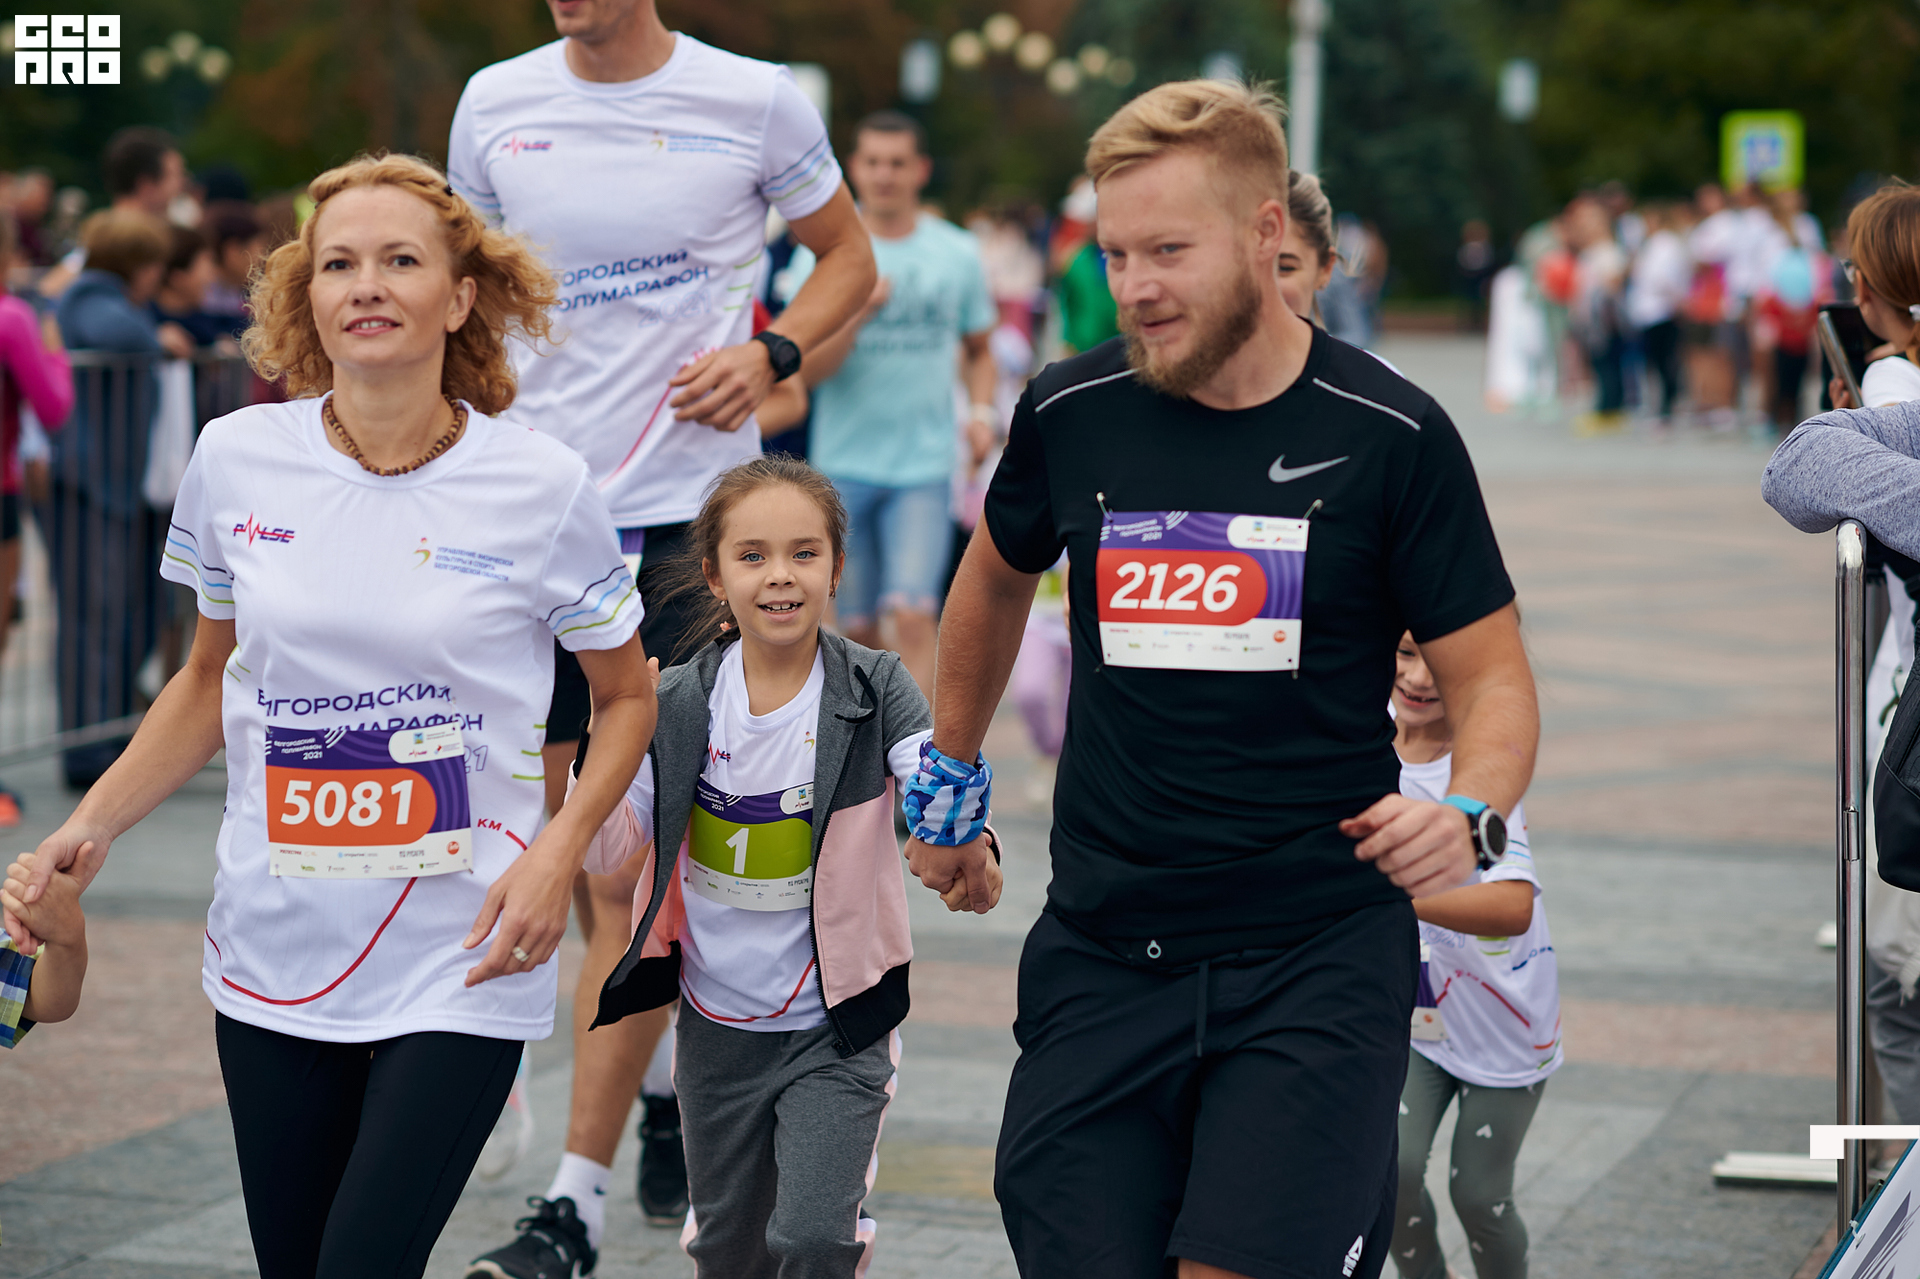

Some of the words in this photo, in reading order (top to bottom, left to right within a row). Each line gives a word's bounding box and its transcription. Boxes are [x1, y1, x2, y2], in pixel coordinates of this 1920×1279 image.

[555, 265, 709, 312] ОЛУМАРАФОН
[562, 248, 688, 287] ОРОДСКИЙ
[1109, 561, 1242, 613] 2126
[303, 751, 323, 760] 2021
[280, 779, 414, 827] 5081
[711, 802, 724, 812] 2021
[725, 827, 750, 875] 1
